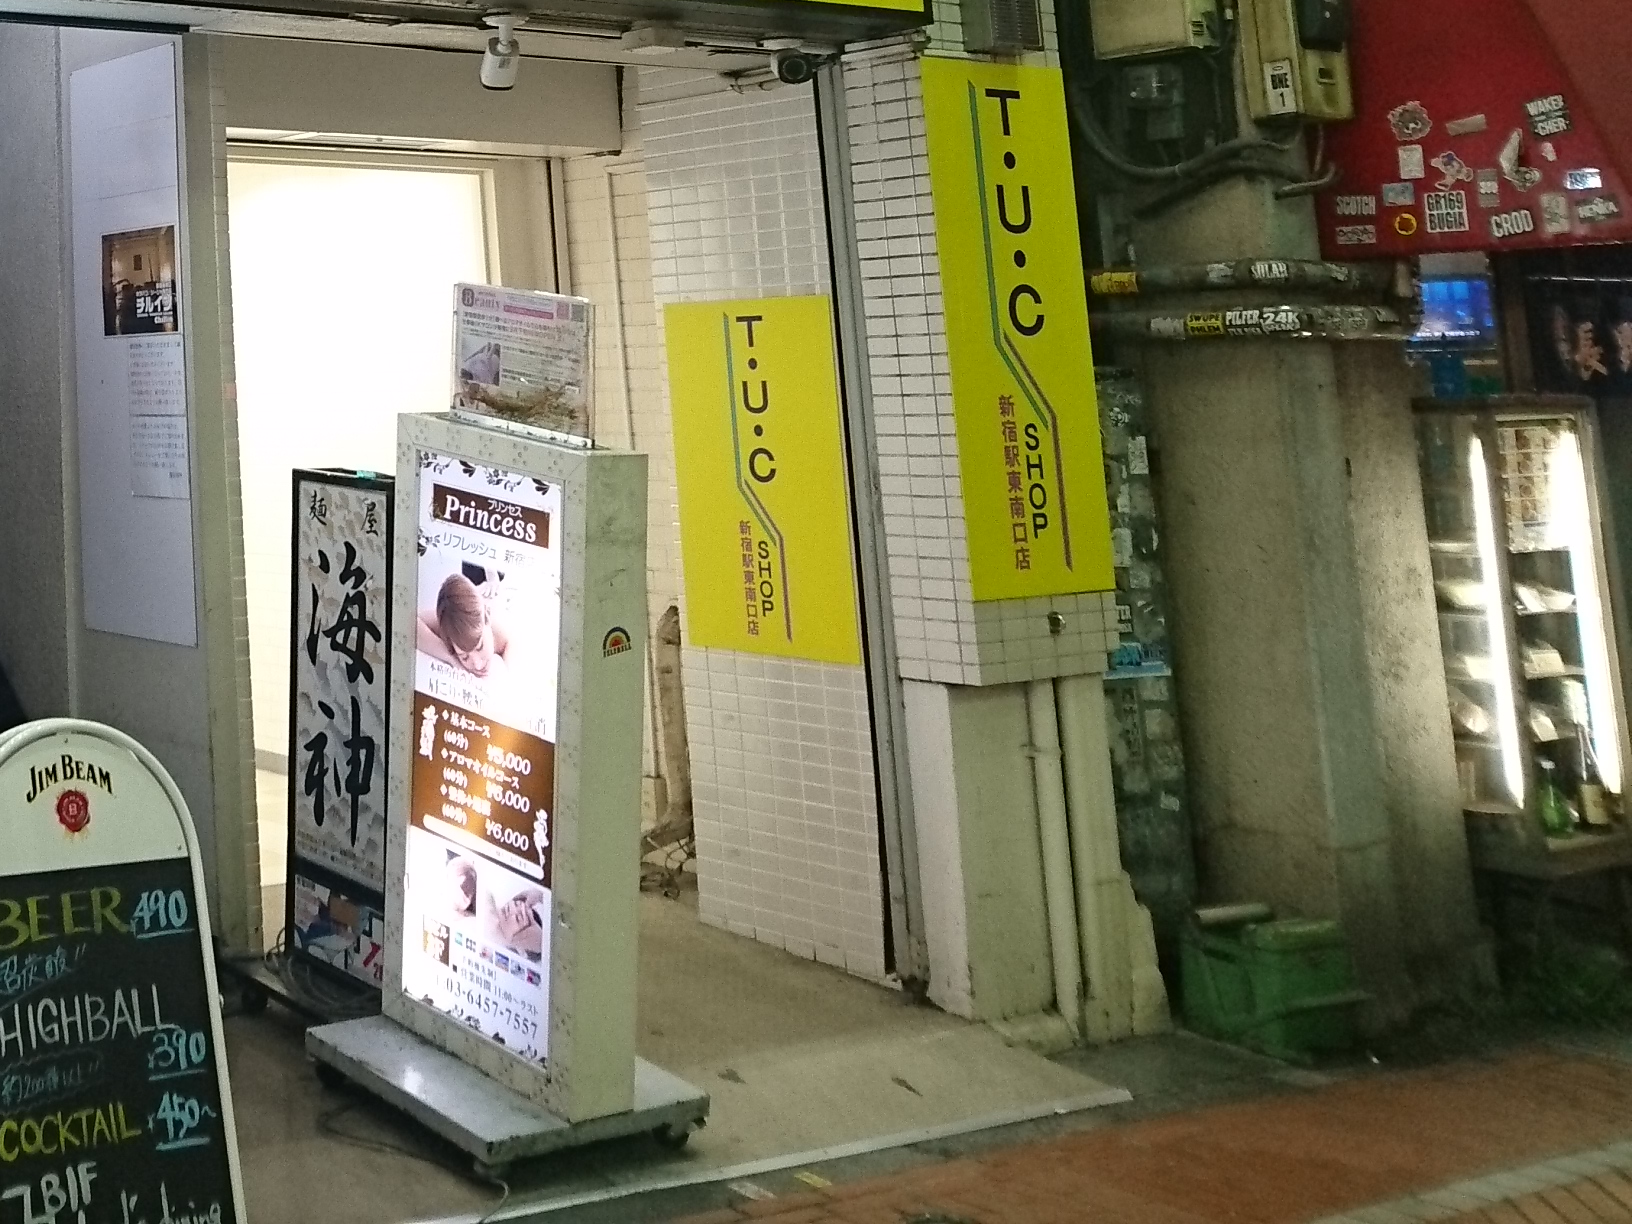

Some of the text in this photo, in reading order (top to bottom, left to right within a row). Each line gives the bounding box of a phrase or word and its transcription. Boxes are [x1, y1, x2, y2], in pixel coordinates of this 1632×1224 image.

[487, 499, 523, 518] プリンセス
[998, 394, 1031, 571] 新宿駅東南口店
[1025, 423, 1049, 539] SHOP
[442, 531, 497, 560] リフレッシュ
[444, 494, 536, 544] Princess
[739, 520, 759, 636] 新宿駅東南口店
[757, 541, 774, 618] SHOP
[303, 541, 381, 848] 海神
[26, 754, 114, 803] JIM BEAM
[0, 984, 180, 1058] HIGHBALL
